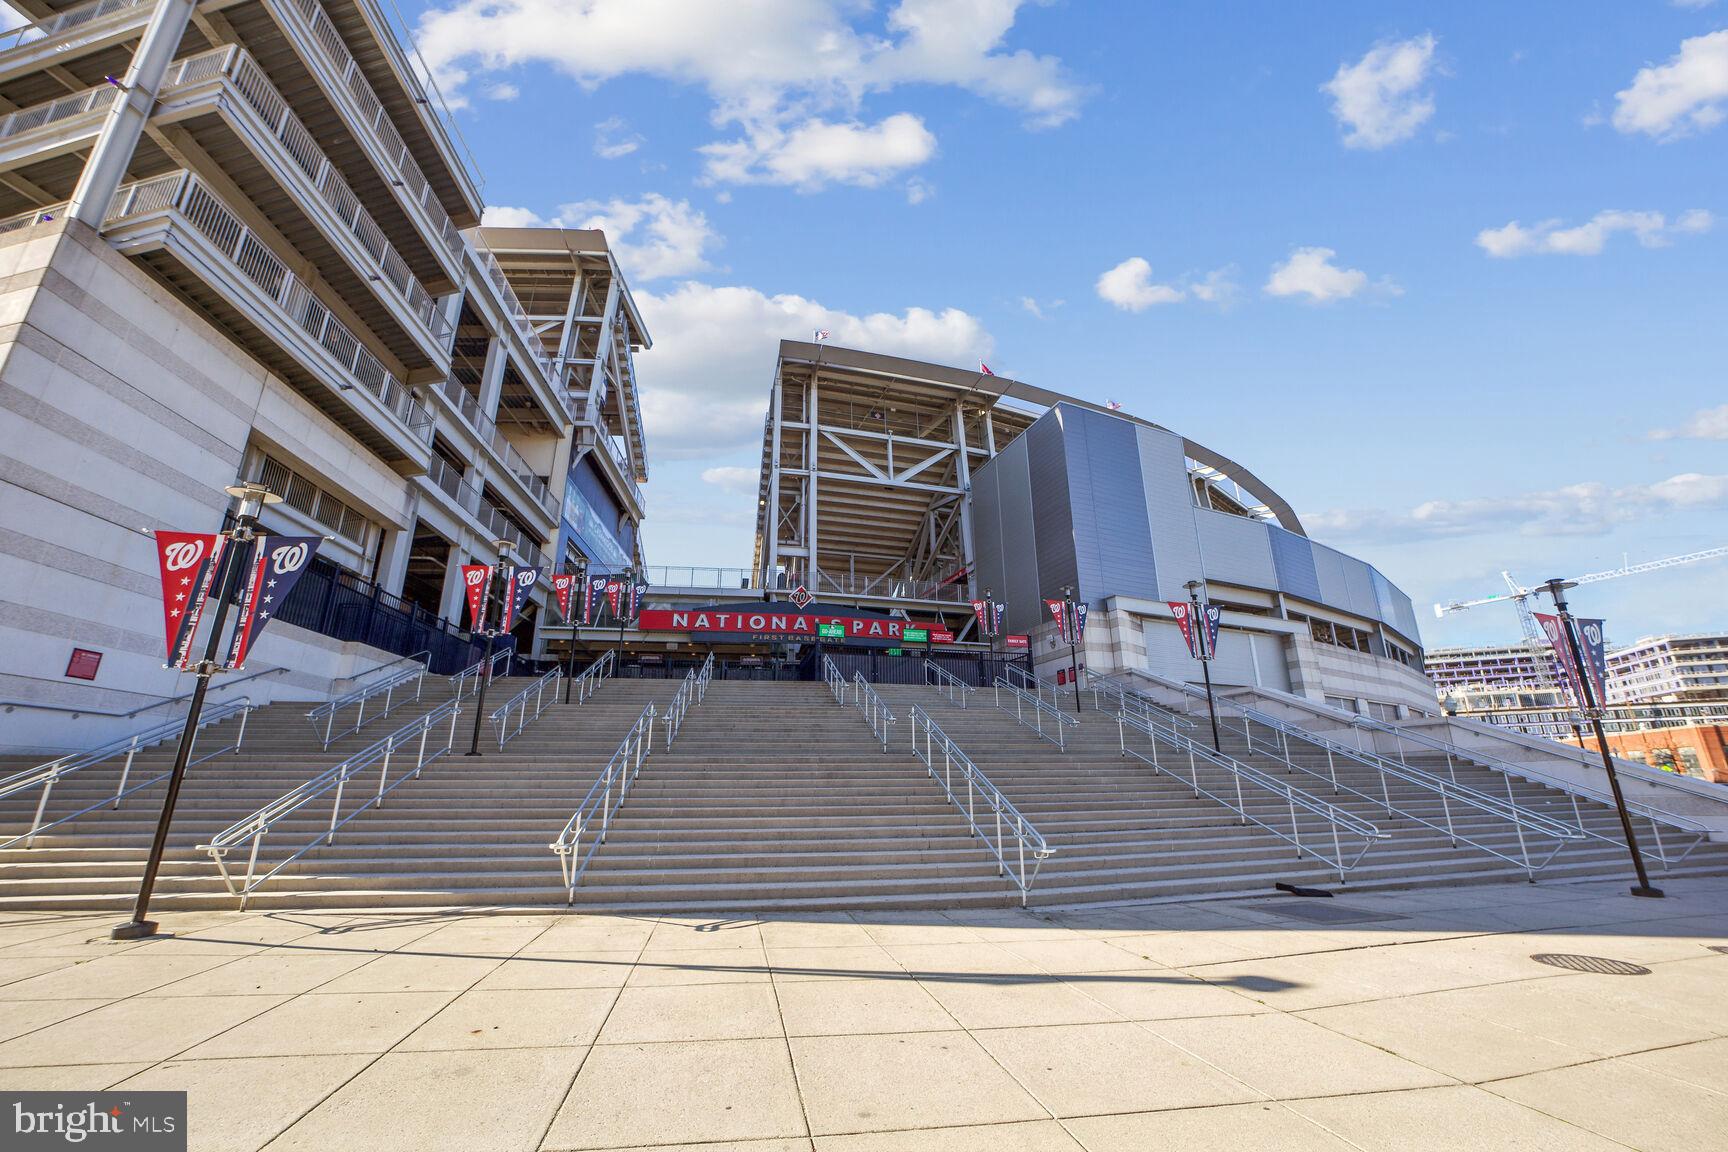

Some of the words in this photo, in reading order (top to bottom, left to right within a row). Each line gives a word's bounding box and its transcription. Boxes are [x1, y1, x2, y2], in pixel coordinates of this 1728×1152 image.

[165, 539, 204, 571] W
[271, 542, 309, 574] W
[466, 569, 484, 586] W
[517, 569, 536, 587] W
[555, 577, 570, 589] W
[592, 578, 607, 590] W
[607, 583, 618, 594] W
[635, 584, 646, 595] W
[1173, 605, 1185, 618] W
[1207, 607, 1218, 620] W
[1543, 620, 1558, 642] W
[1583, 624, 1600, 646] W
